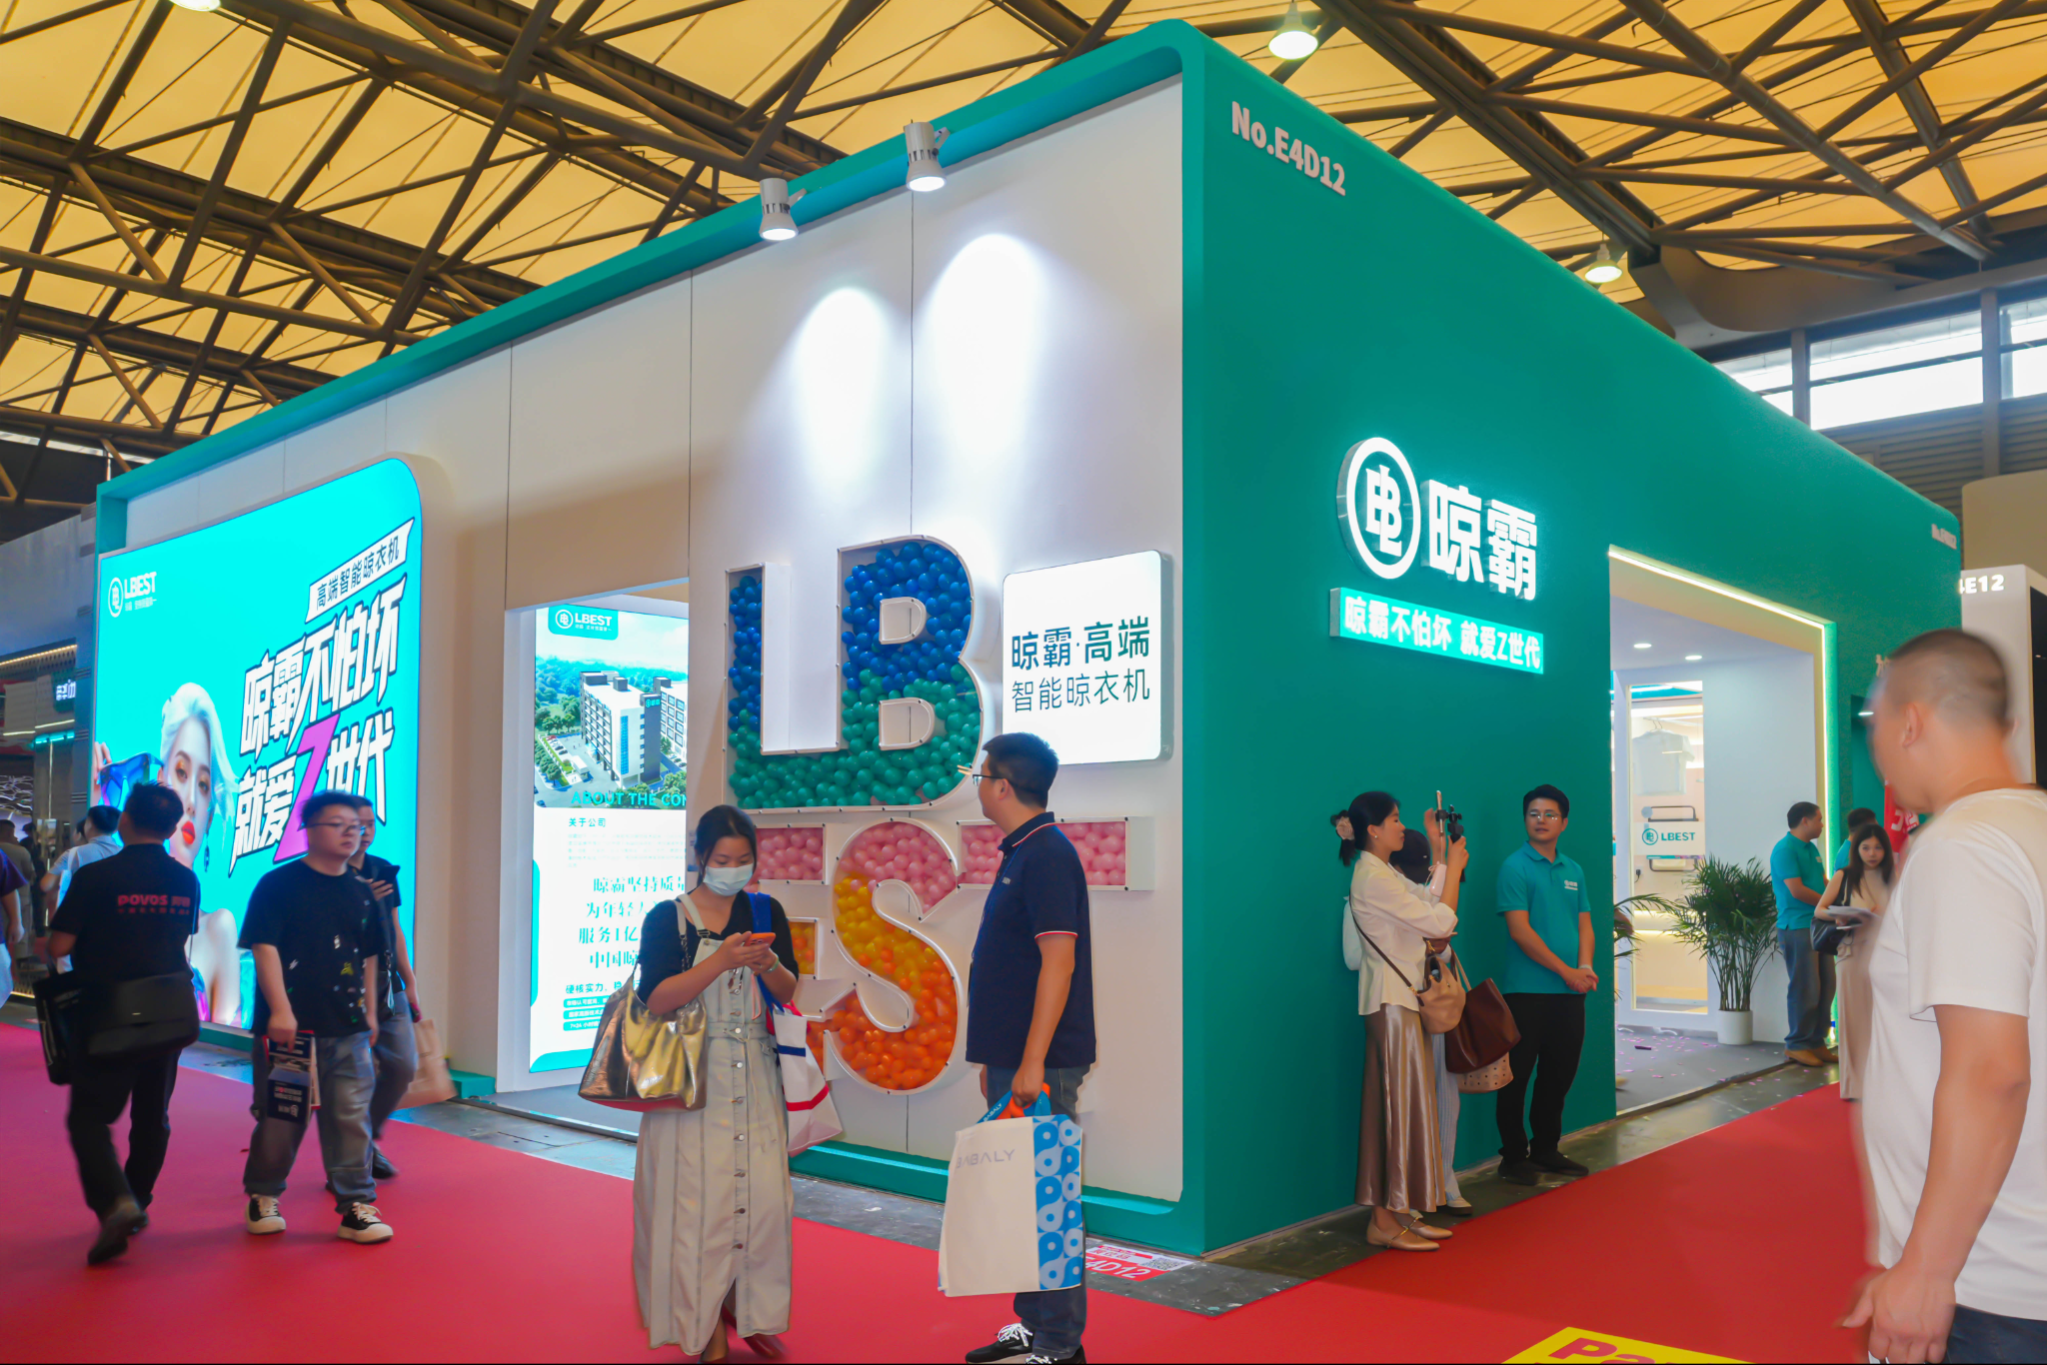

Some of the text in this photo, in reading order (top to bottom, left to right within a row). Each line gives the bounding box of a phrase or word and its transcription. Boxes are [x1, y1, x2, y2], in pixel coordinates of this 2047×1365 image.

[1232, 101, 1346, 196] No.E4D12
[1426, 479, 1537, 600] 晾霸
[124, 571, 157, 599] LBEST
[316, 535, 399, 611] 高端智能晾衣机
[575, 612, 612, 626] LBEST
[1344, 595, 1541, 669] 晾霸不怕坏 就爱Z世代
[240, 572, 407, 763] 晾霸不怕坏
[1012, 668, 1150, 713] 智能晾衣机
[571, 791, 624, 805] ABOUT
[628, 792, 657, 806] THE
[568, 817, 606, 828] 关于公司
[1661, 832, 1696, 841] LBEST
[118, 894, 168, 906] POVOS
[586, 901, 659, 919] 为年轻人
[1086, 1255, 1151, 1279] 4D12
